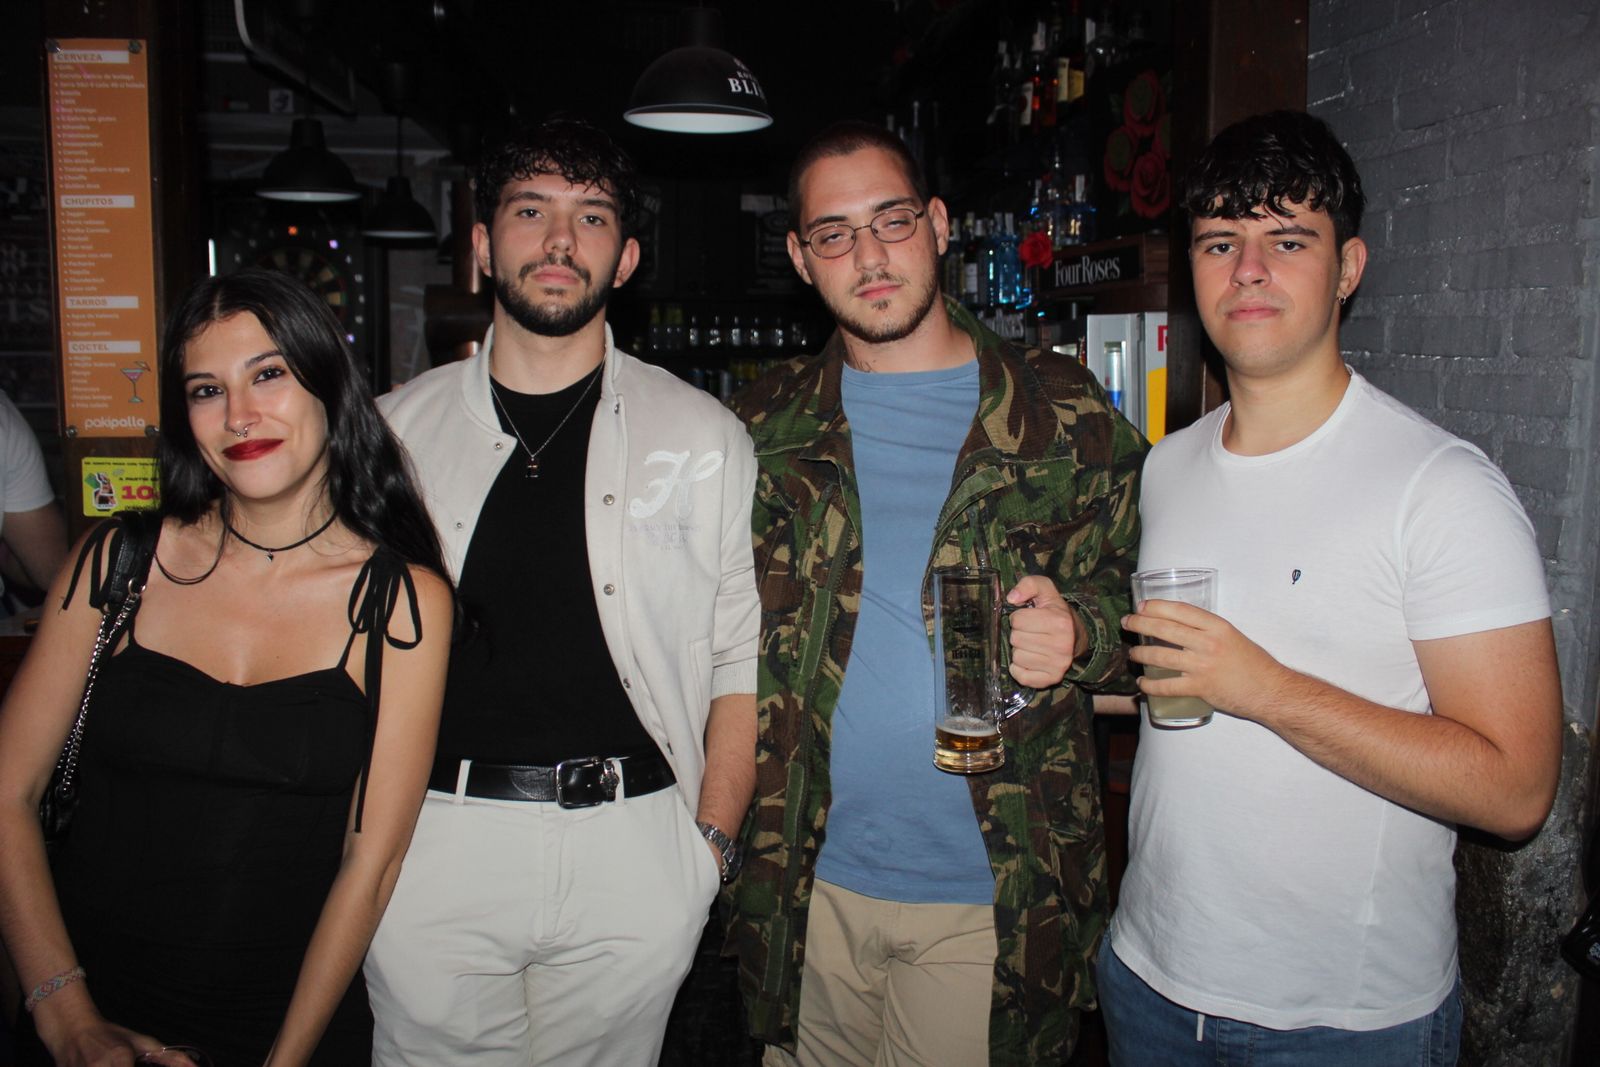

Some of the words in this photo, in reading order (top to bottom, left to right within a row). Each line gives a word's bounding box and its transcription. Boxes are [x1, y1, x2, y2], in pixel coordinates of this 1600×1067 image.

[57, 53, 103, 61] CERVEZA
[64, 198, 114, 206] CHUPITOS
[70, 298, 108, 306] TARROS
[72, 343, 109, 351] COCTEL
